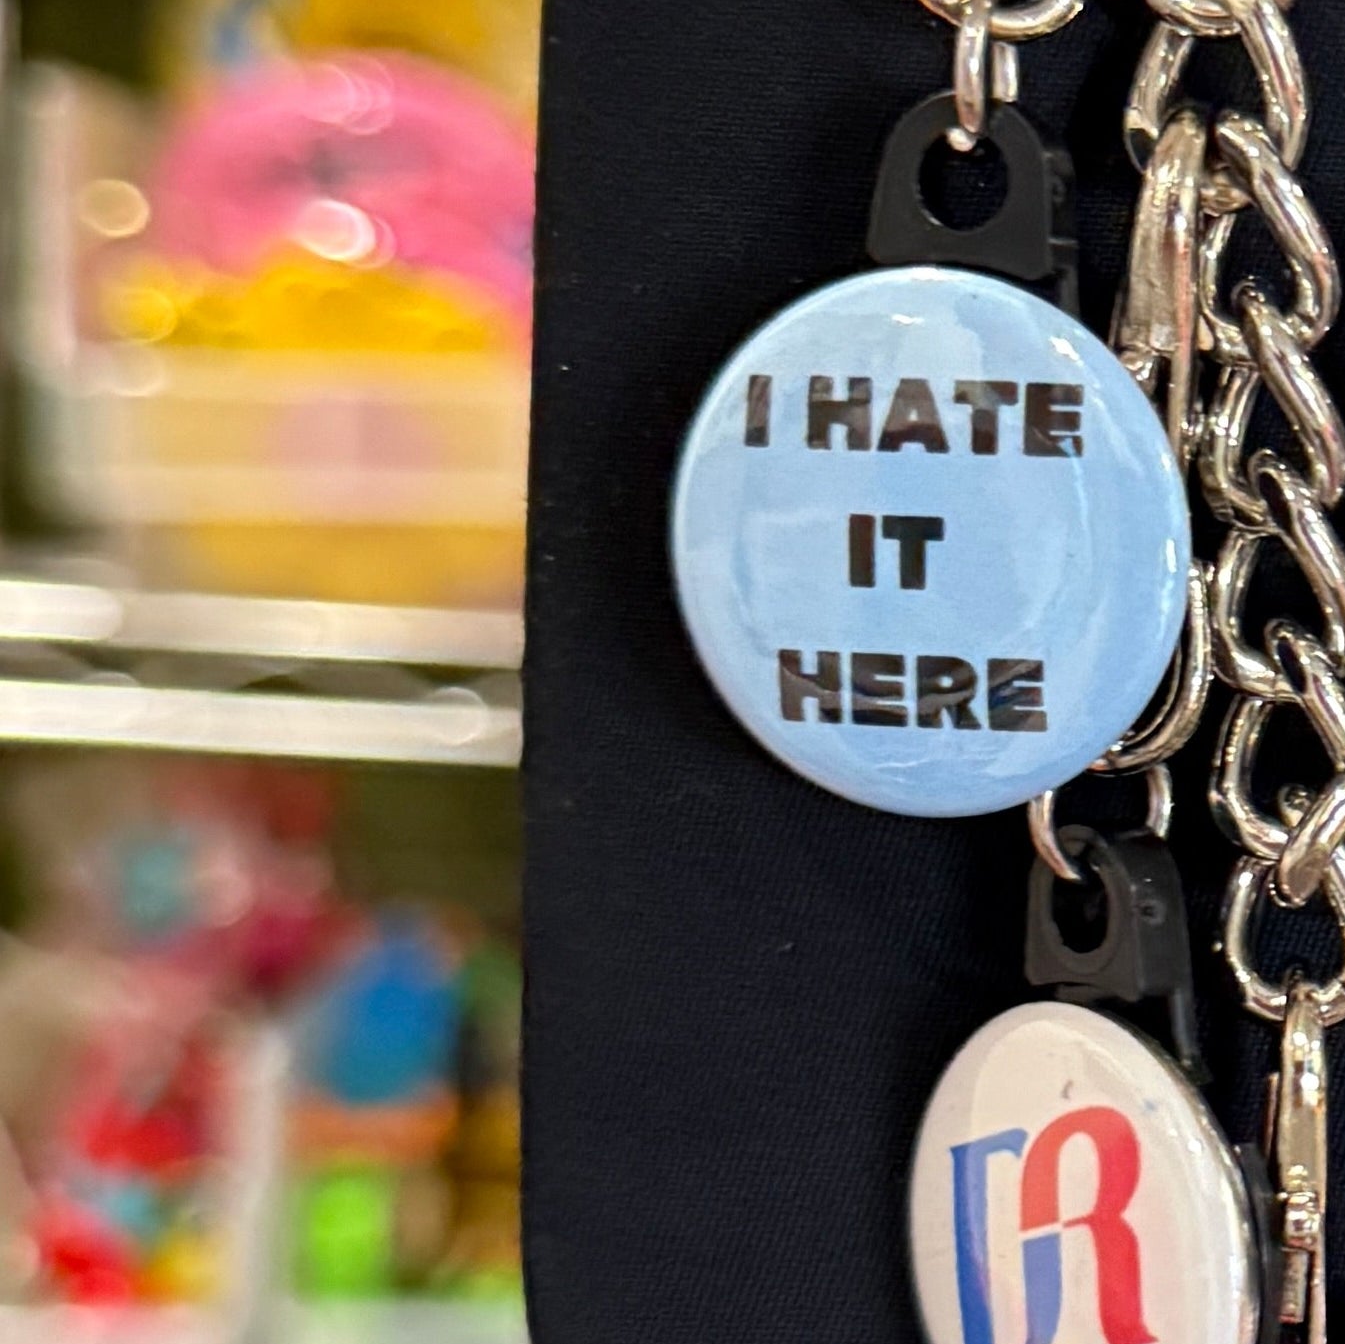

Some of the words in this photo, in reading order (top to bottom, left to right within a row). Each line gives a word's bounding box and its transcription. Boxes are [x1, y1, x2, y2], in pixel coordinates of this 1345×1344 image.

[744, 374, 773, 448] I
[806, 375, 1085, 458] HATE
[849, 513, 945, 591] IT
[778, 649, 1048, 732] HERE
